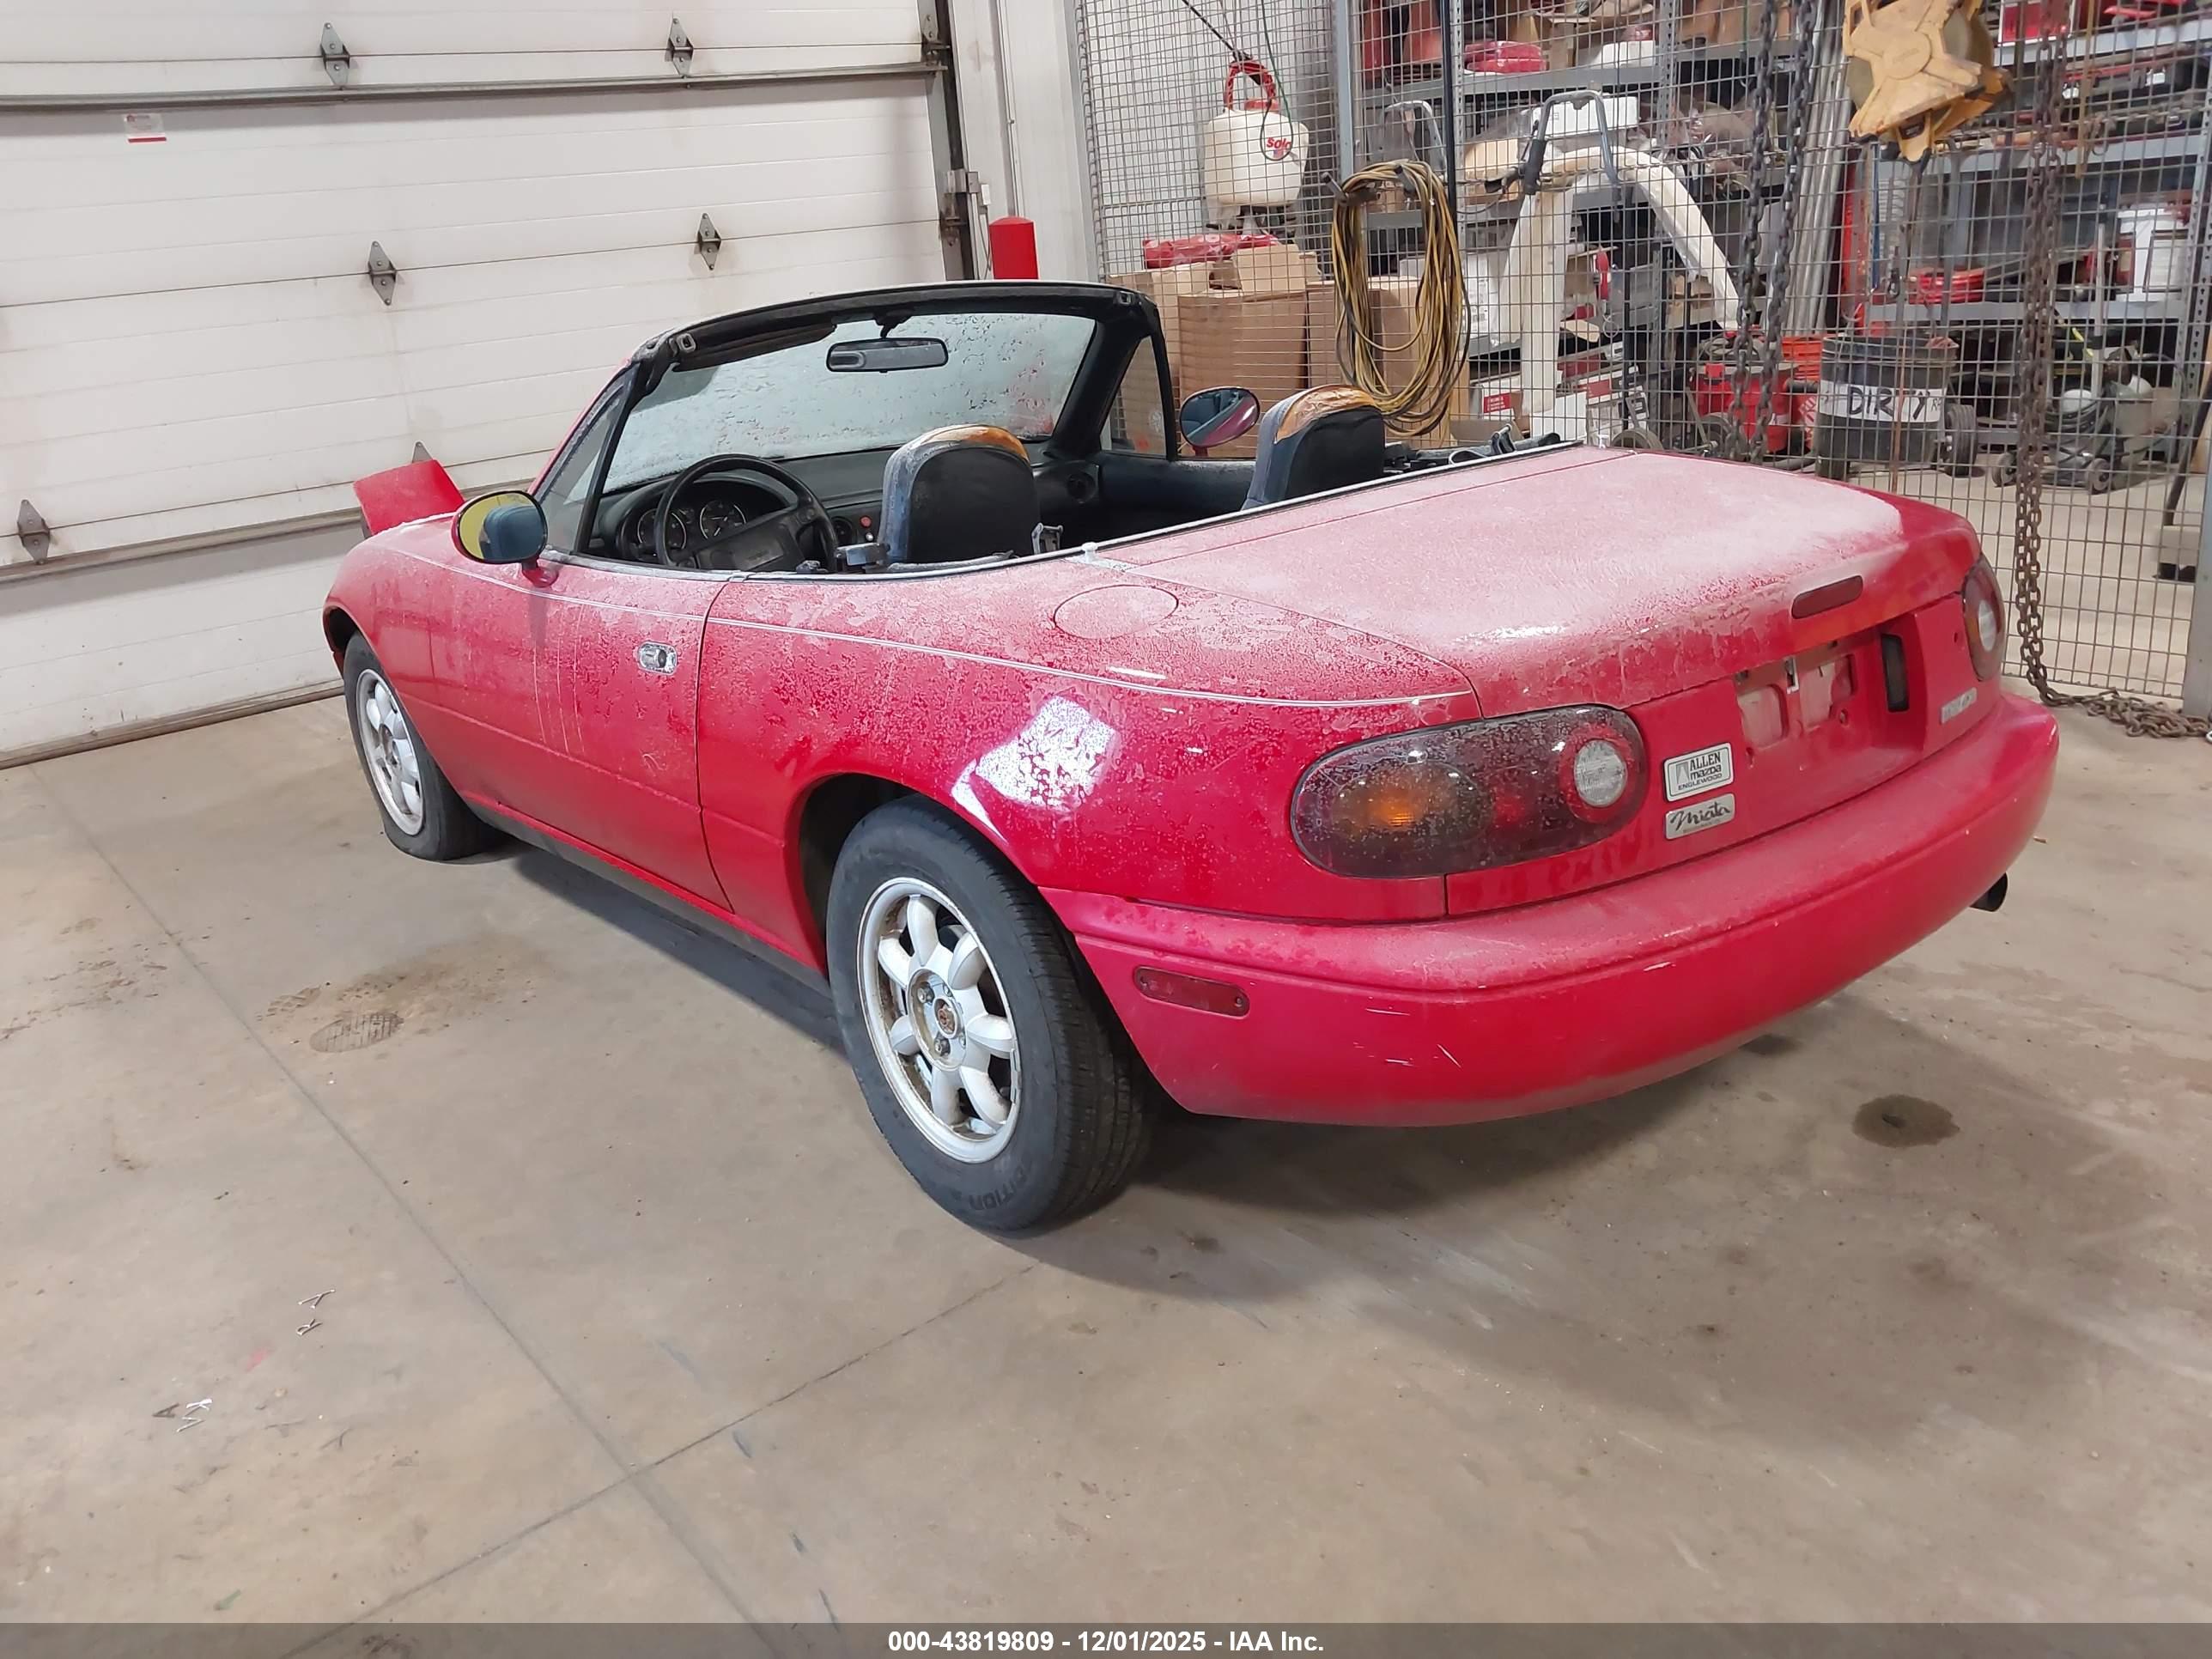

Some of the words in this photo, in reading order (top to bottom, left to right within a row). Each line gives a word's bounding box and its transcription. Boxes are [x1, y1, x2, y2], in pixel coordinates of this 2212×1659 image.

[1848, 386, 1930, 420] DIRTY
[1689, 751, 1722, 772] ALLEN
[1678, 773, 1723, 790] ENGLEWOOD
[1690, 764, 1723, 781] mazda
[1670, 801, 1731, 831] Miata
